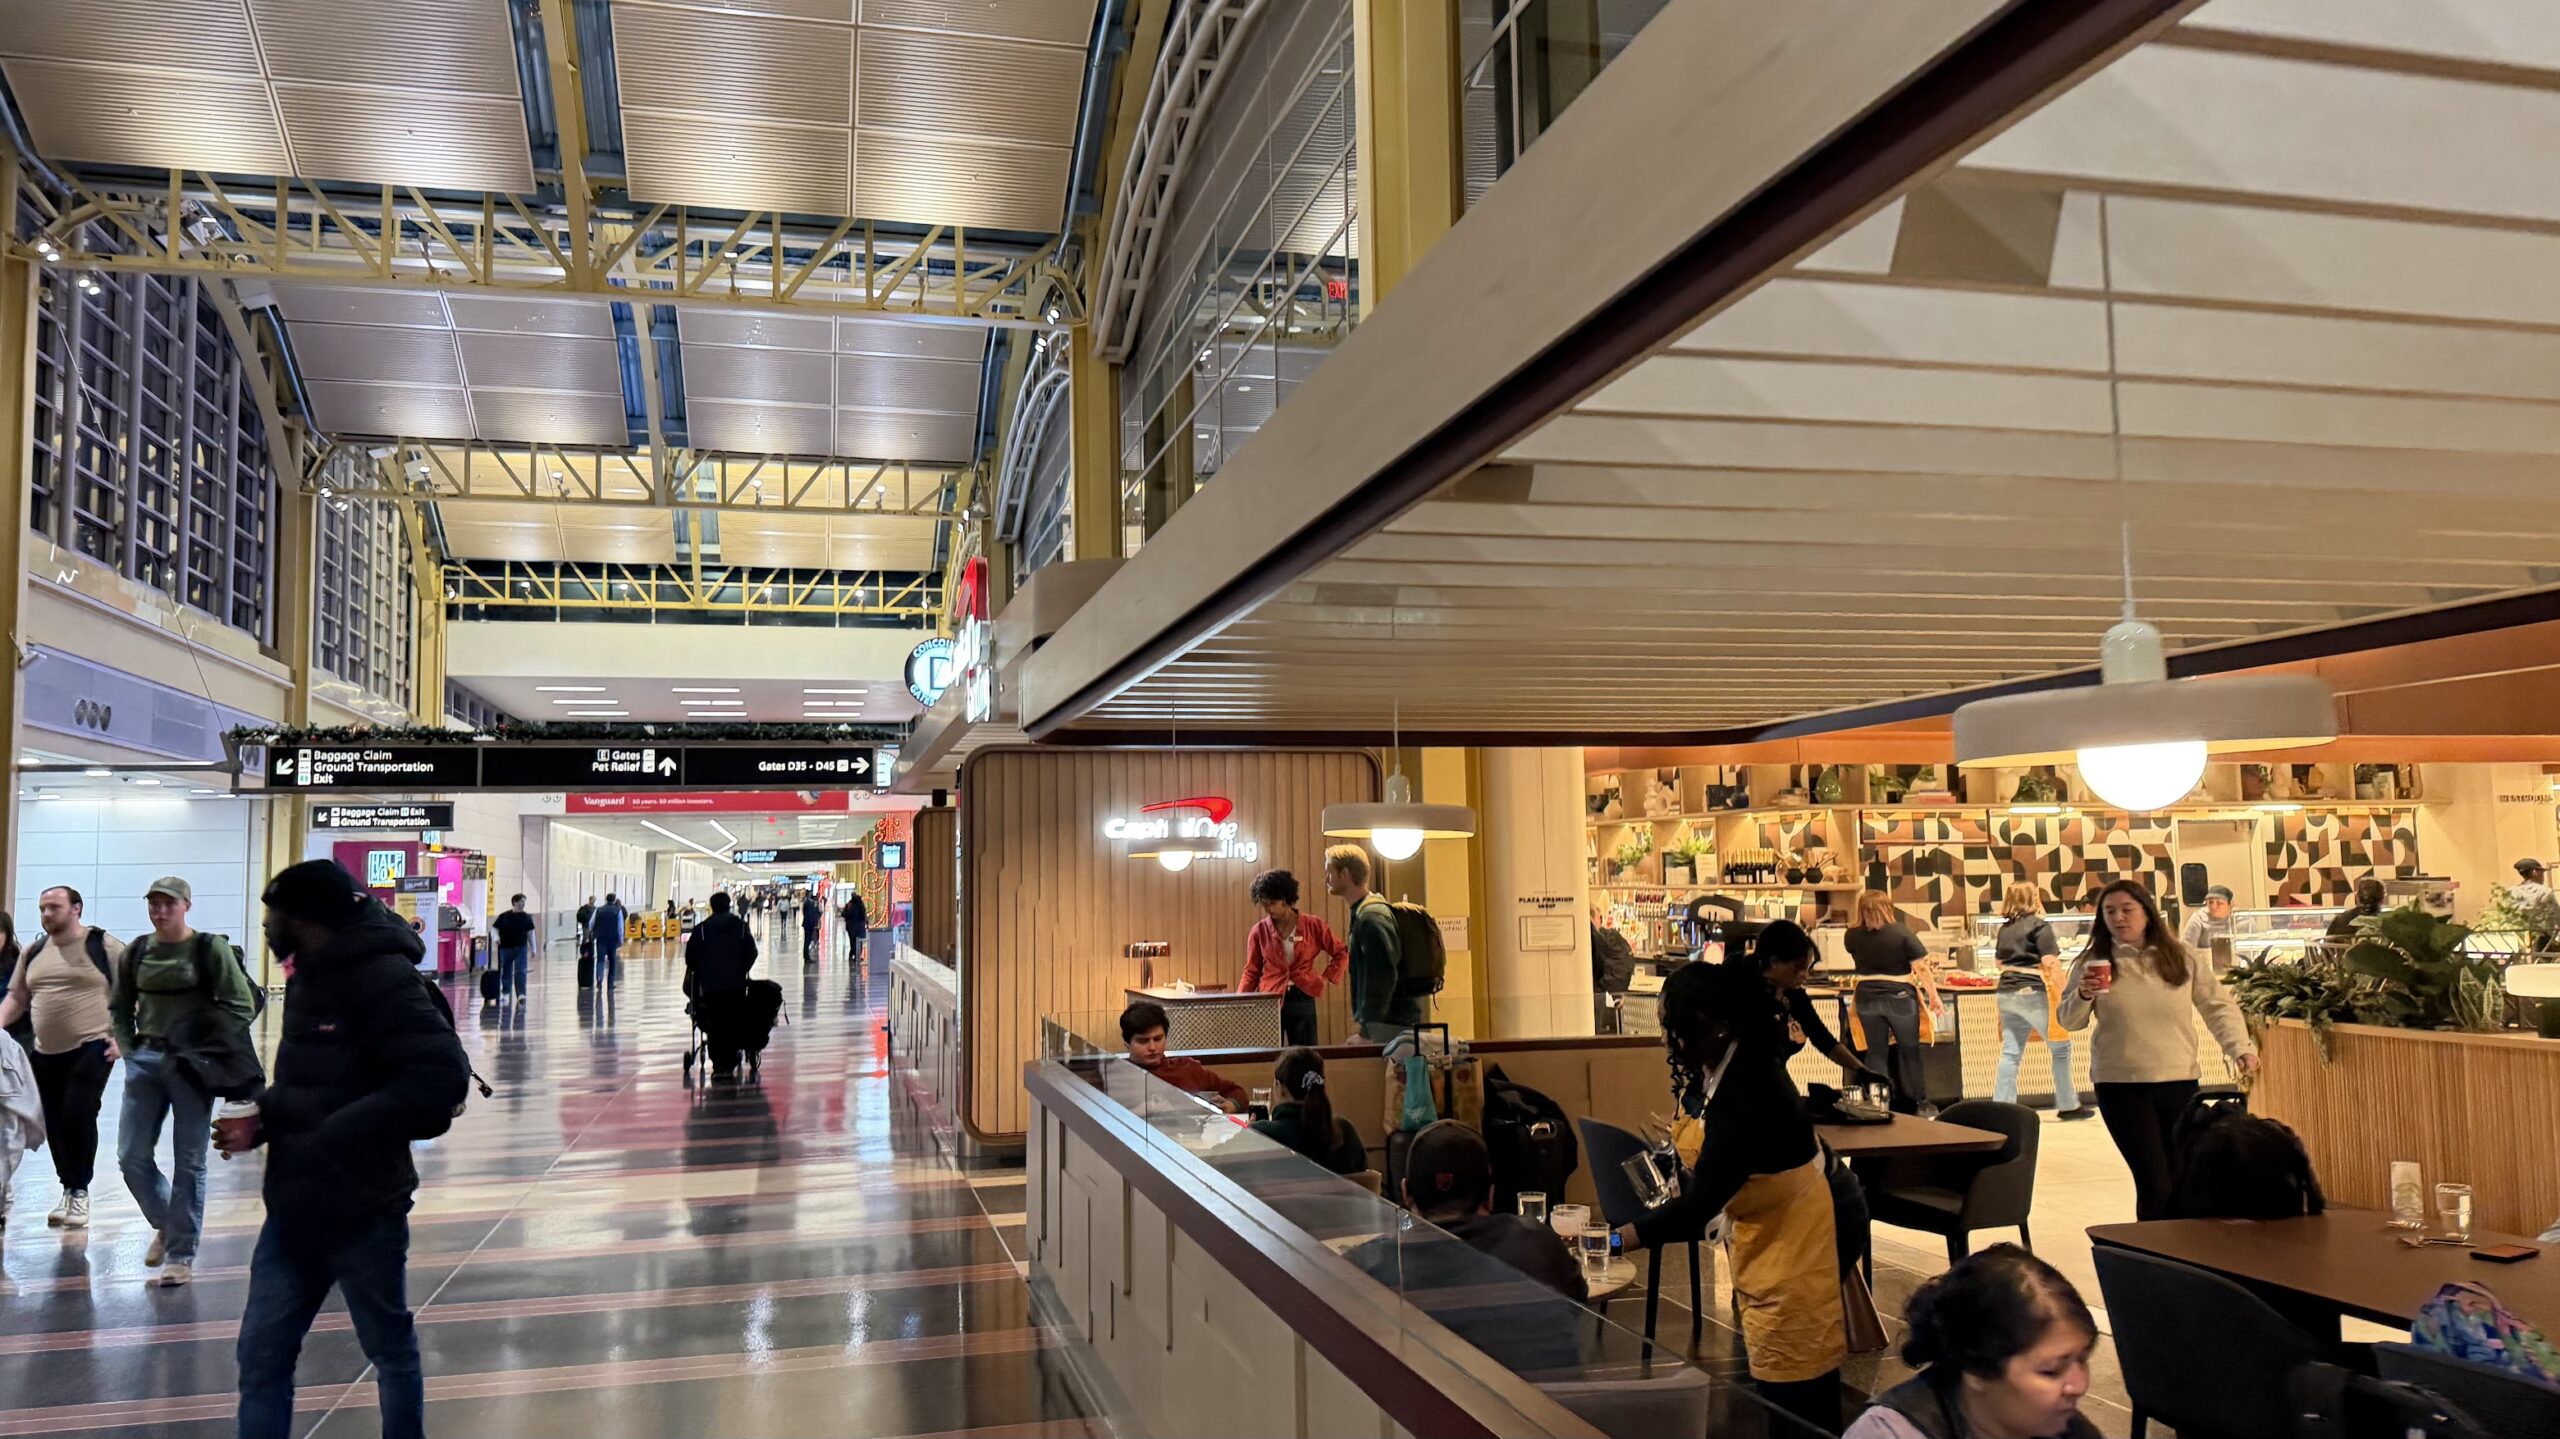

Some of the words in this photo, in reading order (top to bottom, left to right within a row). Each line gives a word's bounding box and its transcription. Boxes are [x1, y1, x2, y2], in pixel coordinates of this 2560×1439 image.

[314, 751, 361, 762] Baggage
[363, 750, 392, 760] Claim
[612, 750, 641, 761] Gates
[313, 761, 354, 772] Ground
[356, 762, 434, 774] Transportation
[592, 761, 609, 772] Pet
[611, 761, 641, 772] Relief
[758, 761, 786, 771] Gates
[788, 761, 807, 771] D35
[815, 761, 835, 771] D45
[313, 773, 334, 784] Exit
[583, 796, 625, 807] Vanguard
[341, 808, 376, 818] Baggage
[377, 807, 399, 816] Claim
[410, 807, 425, 816] Exit
[340, 817, 372, 827] Ground
[373, 817, 431, 828] Transportation
[1518, 896, 1540, 904] PLAZA
[1542, 896, 1574, 904] PREMIUM
